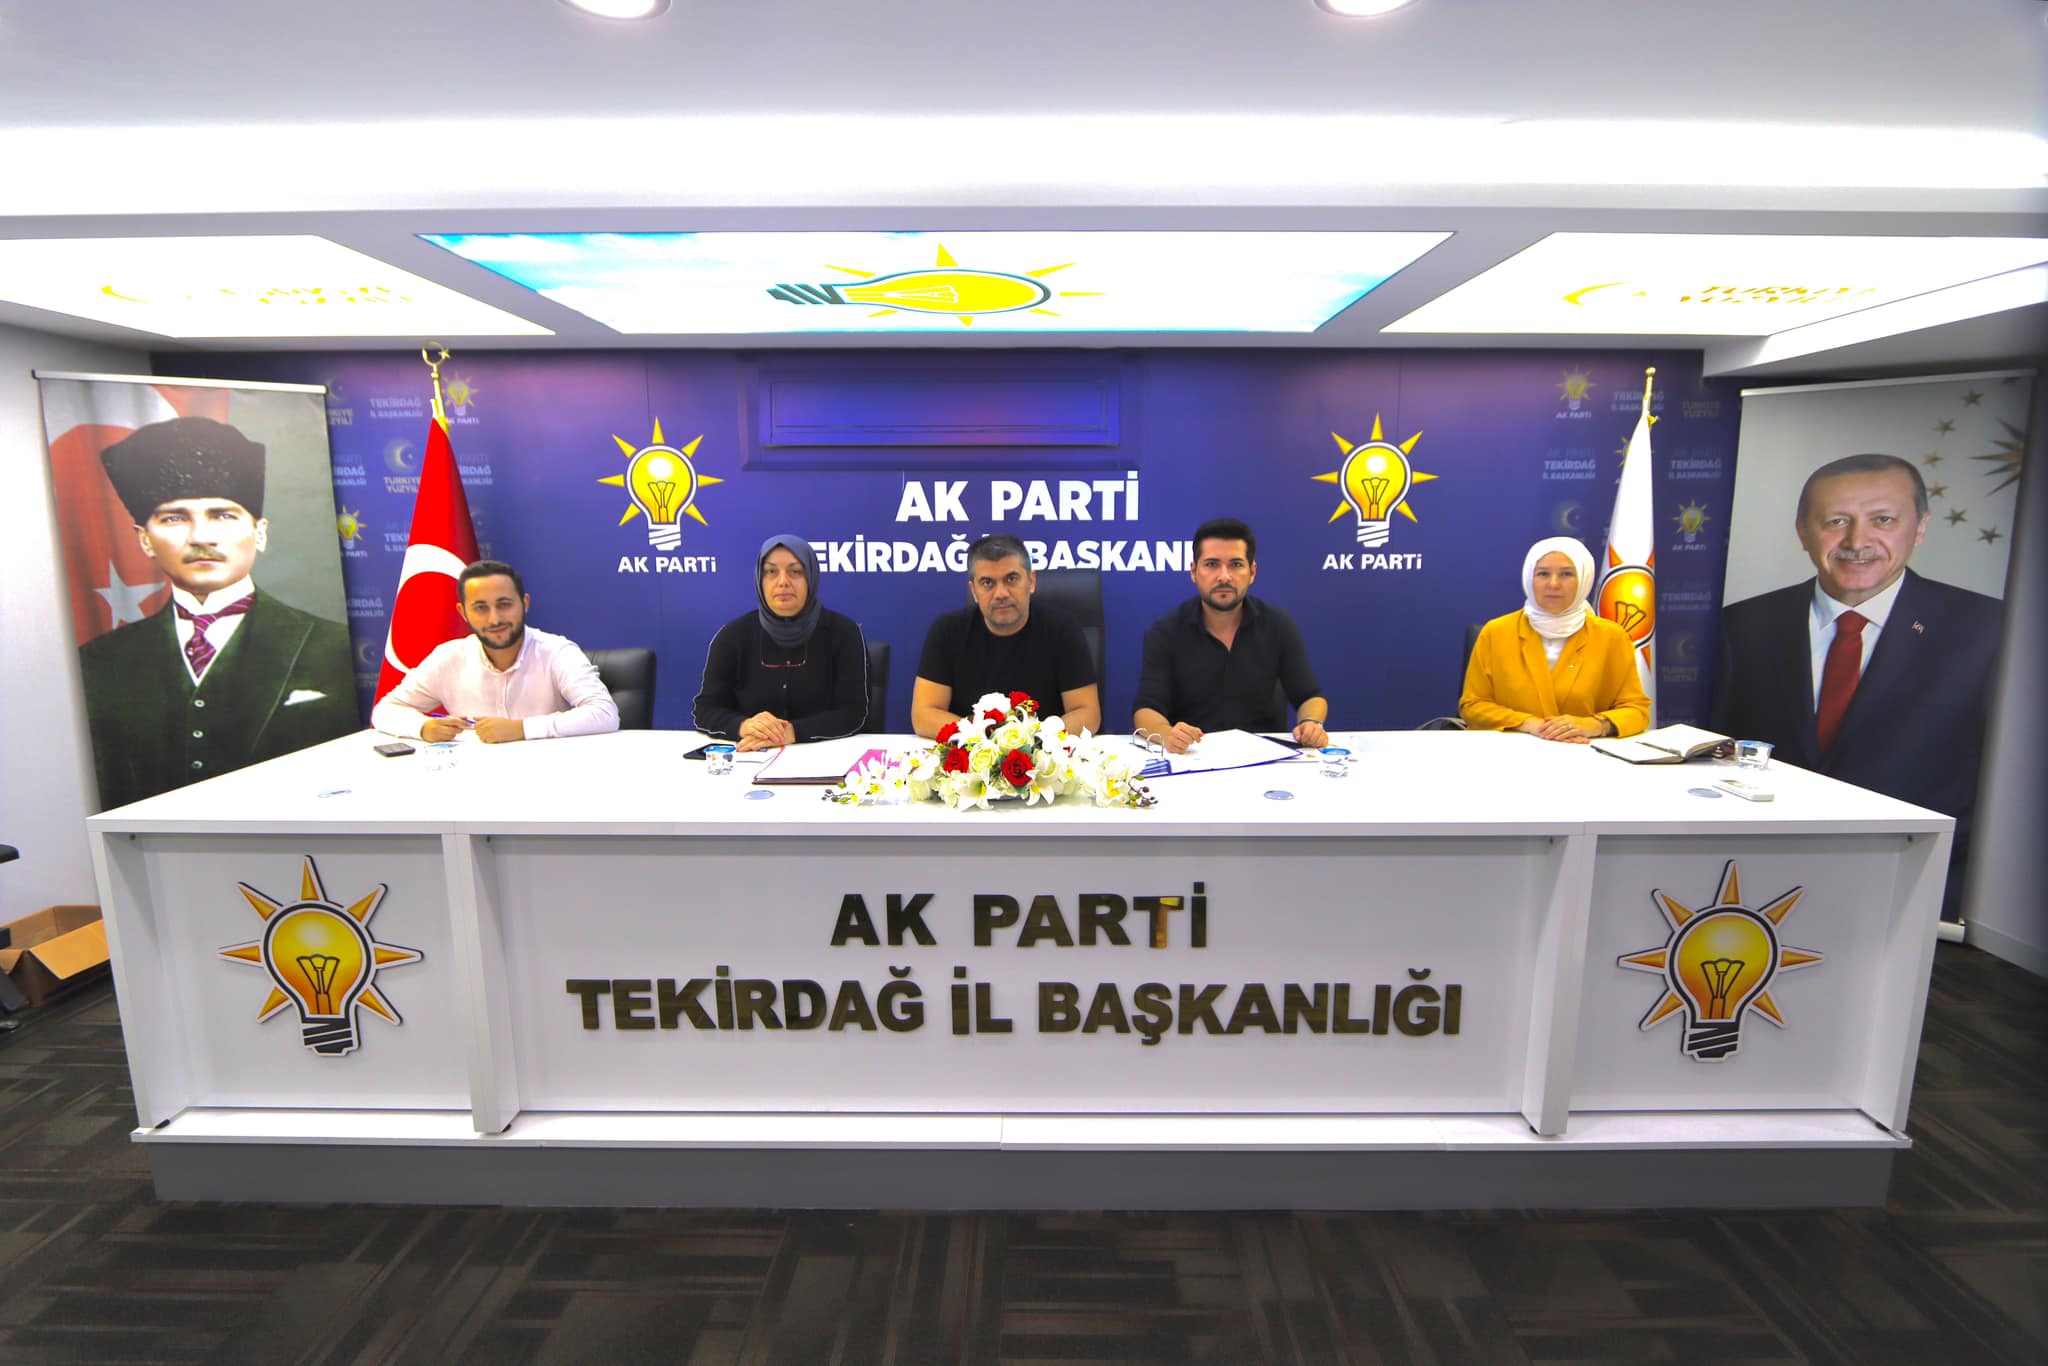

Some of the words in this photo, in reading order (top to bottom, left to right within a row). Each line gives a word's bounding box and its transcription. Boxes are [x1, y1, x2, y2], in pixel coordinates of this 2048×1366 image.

[895, 480, 969, 522] AK
[991, 470, 1139, 521] PARTİ
[618, 556, 649, 573] AK
[808, 534, 970, 573] EKİRDAĞ
[1322, 553, 1354, 570] AK
[830, 893, 937, 948] AK
[973, 881, 1208, 949] PARTİ
[566, 965, 925, 1032] TEKİRDAĞ
[952, 965, 1013, 1036] İL
[1038, 968, 1462, 1046] BAŞKANLIĞI
